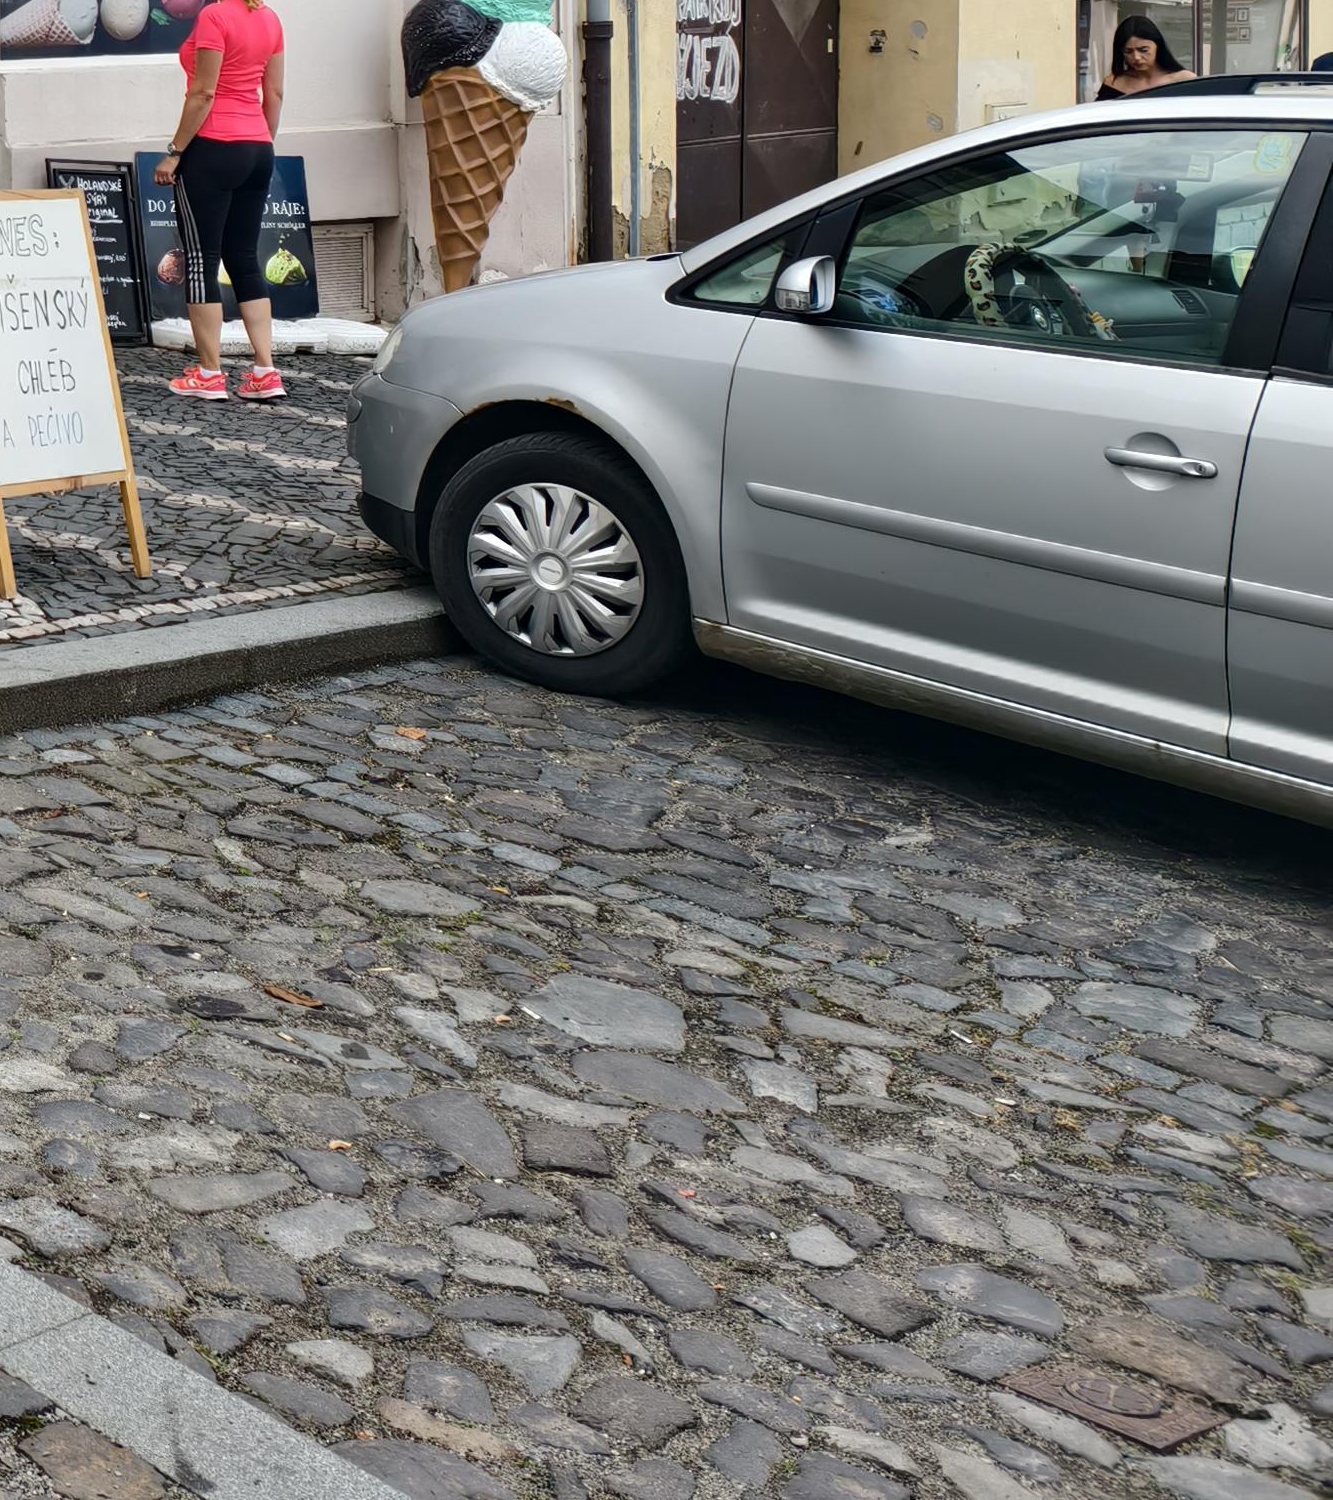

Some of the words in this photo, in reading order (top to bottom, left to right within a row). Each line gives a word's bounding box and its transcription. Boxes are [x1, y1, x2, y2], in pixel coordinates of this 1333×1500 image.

[148, 199, 167, 214] DO
[17, 347, 77, 396] CHLÉB
[3, 418, 16, 449] A
[27, 406, 85, 449] PEČIVO
